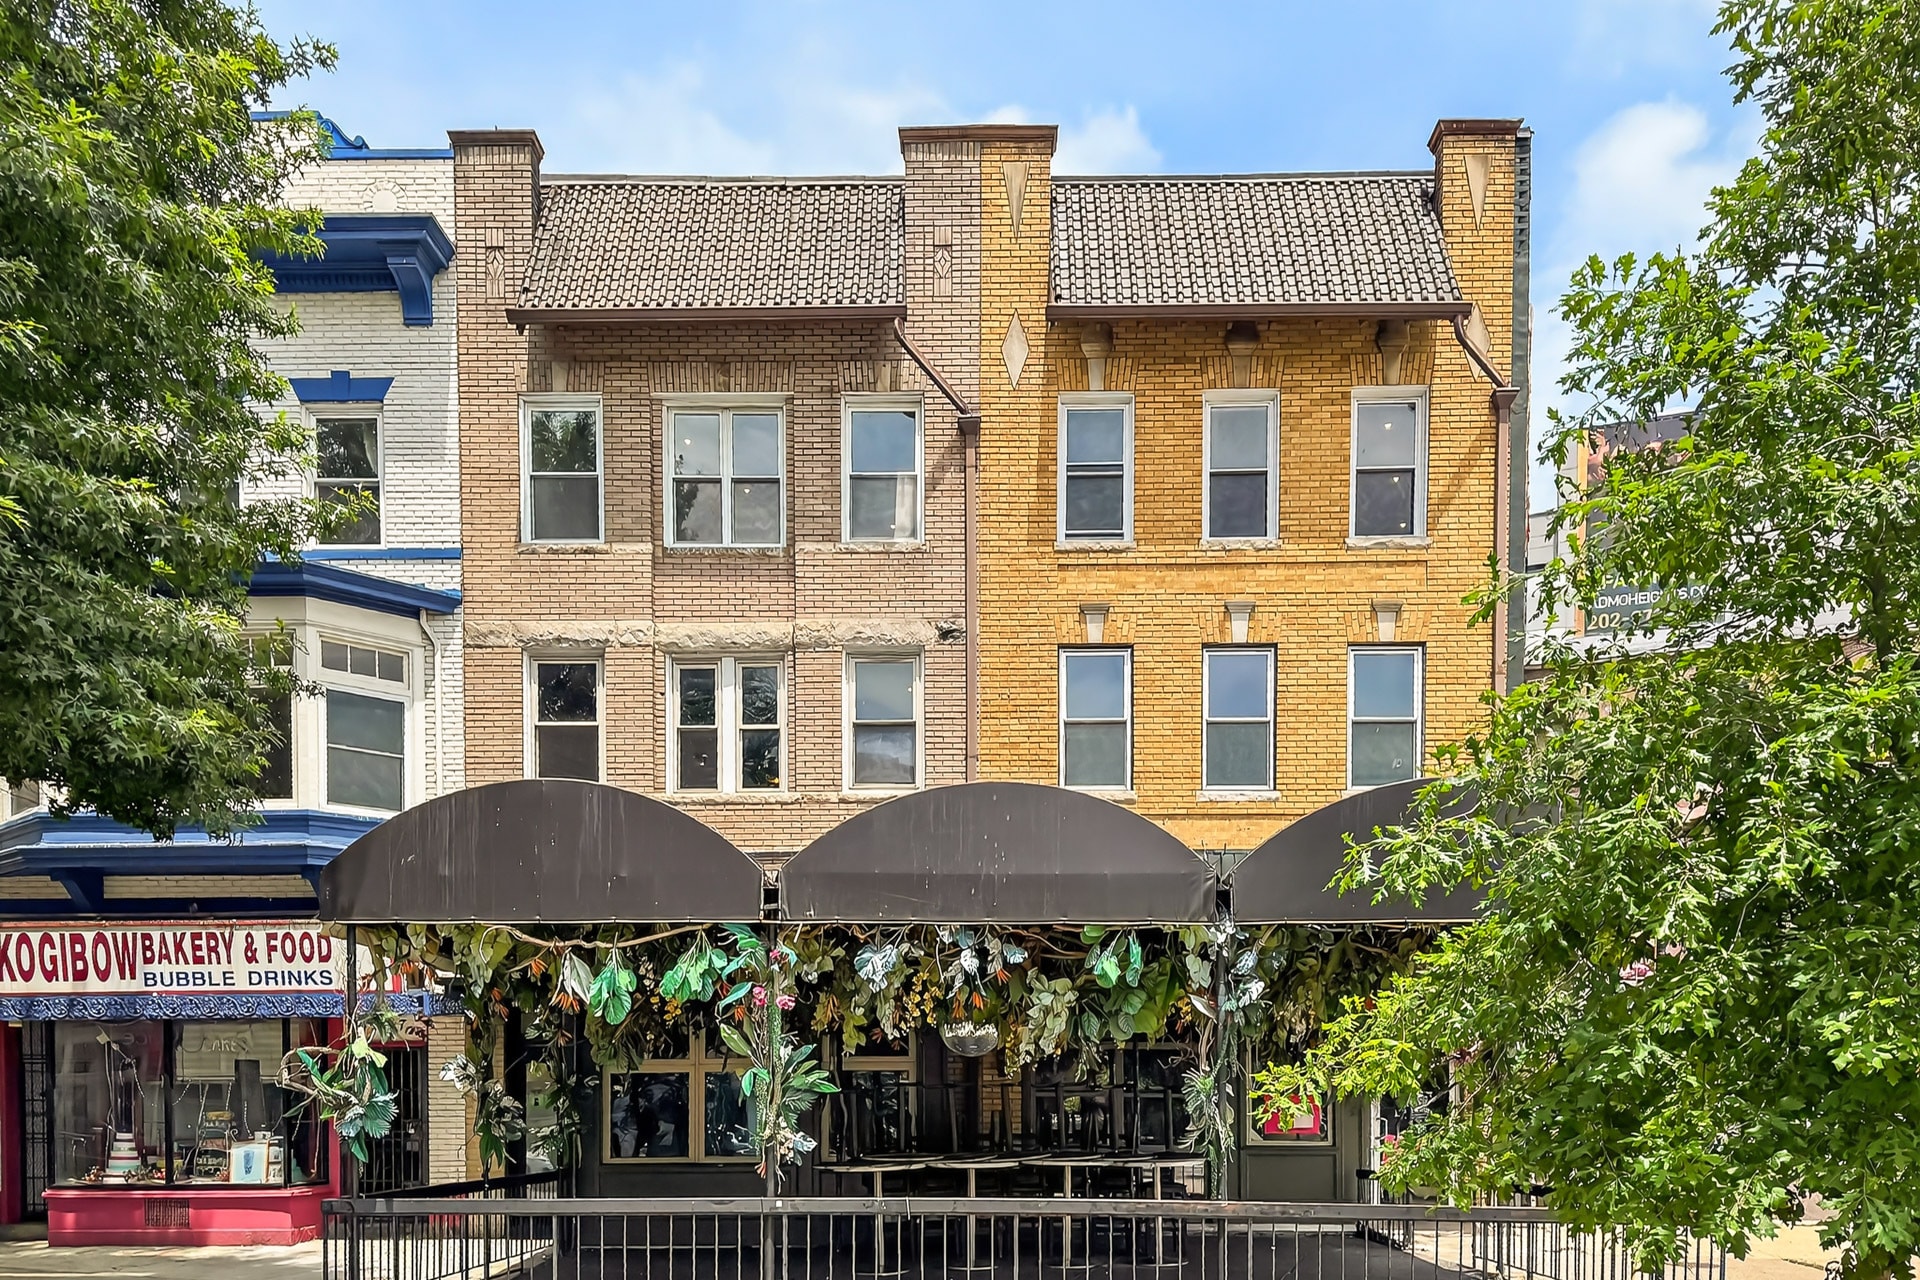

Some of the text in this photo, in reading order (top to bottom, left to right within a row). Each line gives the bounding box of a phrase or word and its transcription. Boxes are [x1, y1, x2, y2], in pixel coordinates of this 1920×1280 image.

[140, 931, 235, 965] BAKERY
[244, 931, 260, 964] &
[265, 931, 332, 964] FOOD
[143, 969, 334, 987] BUBBLE DRINKS
